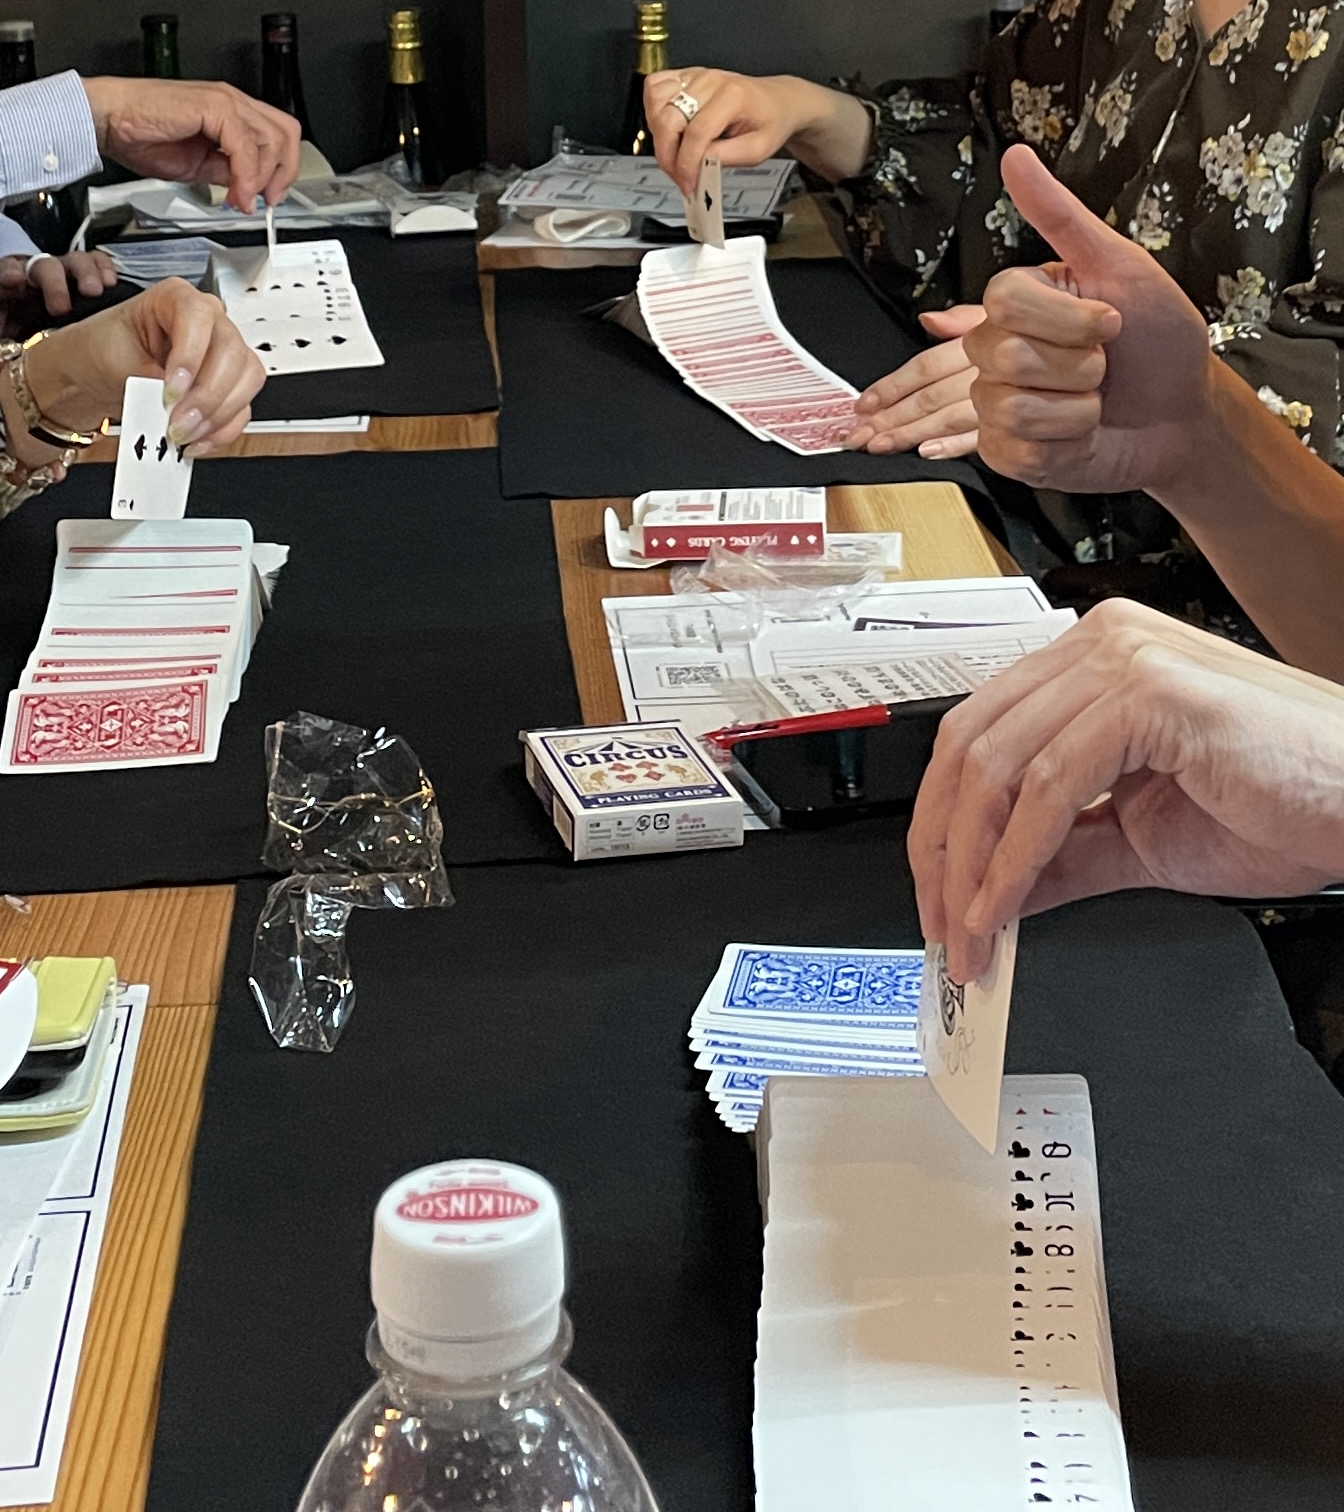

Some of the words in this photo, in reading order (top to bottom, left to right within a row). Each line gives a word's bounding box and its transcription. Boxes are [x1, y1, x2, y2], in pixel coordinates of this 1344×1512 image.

[563, 744, 688, 768] CIRCUS
[596, 792, 657, 804] PLAYING
[664, 787, 714, 799] CARDS
[403, 1190, 533, 1219] WILKINSON
